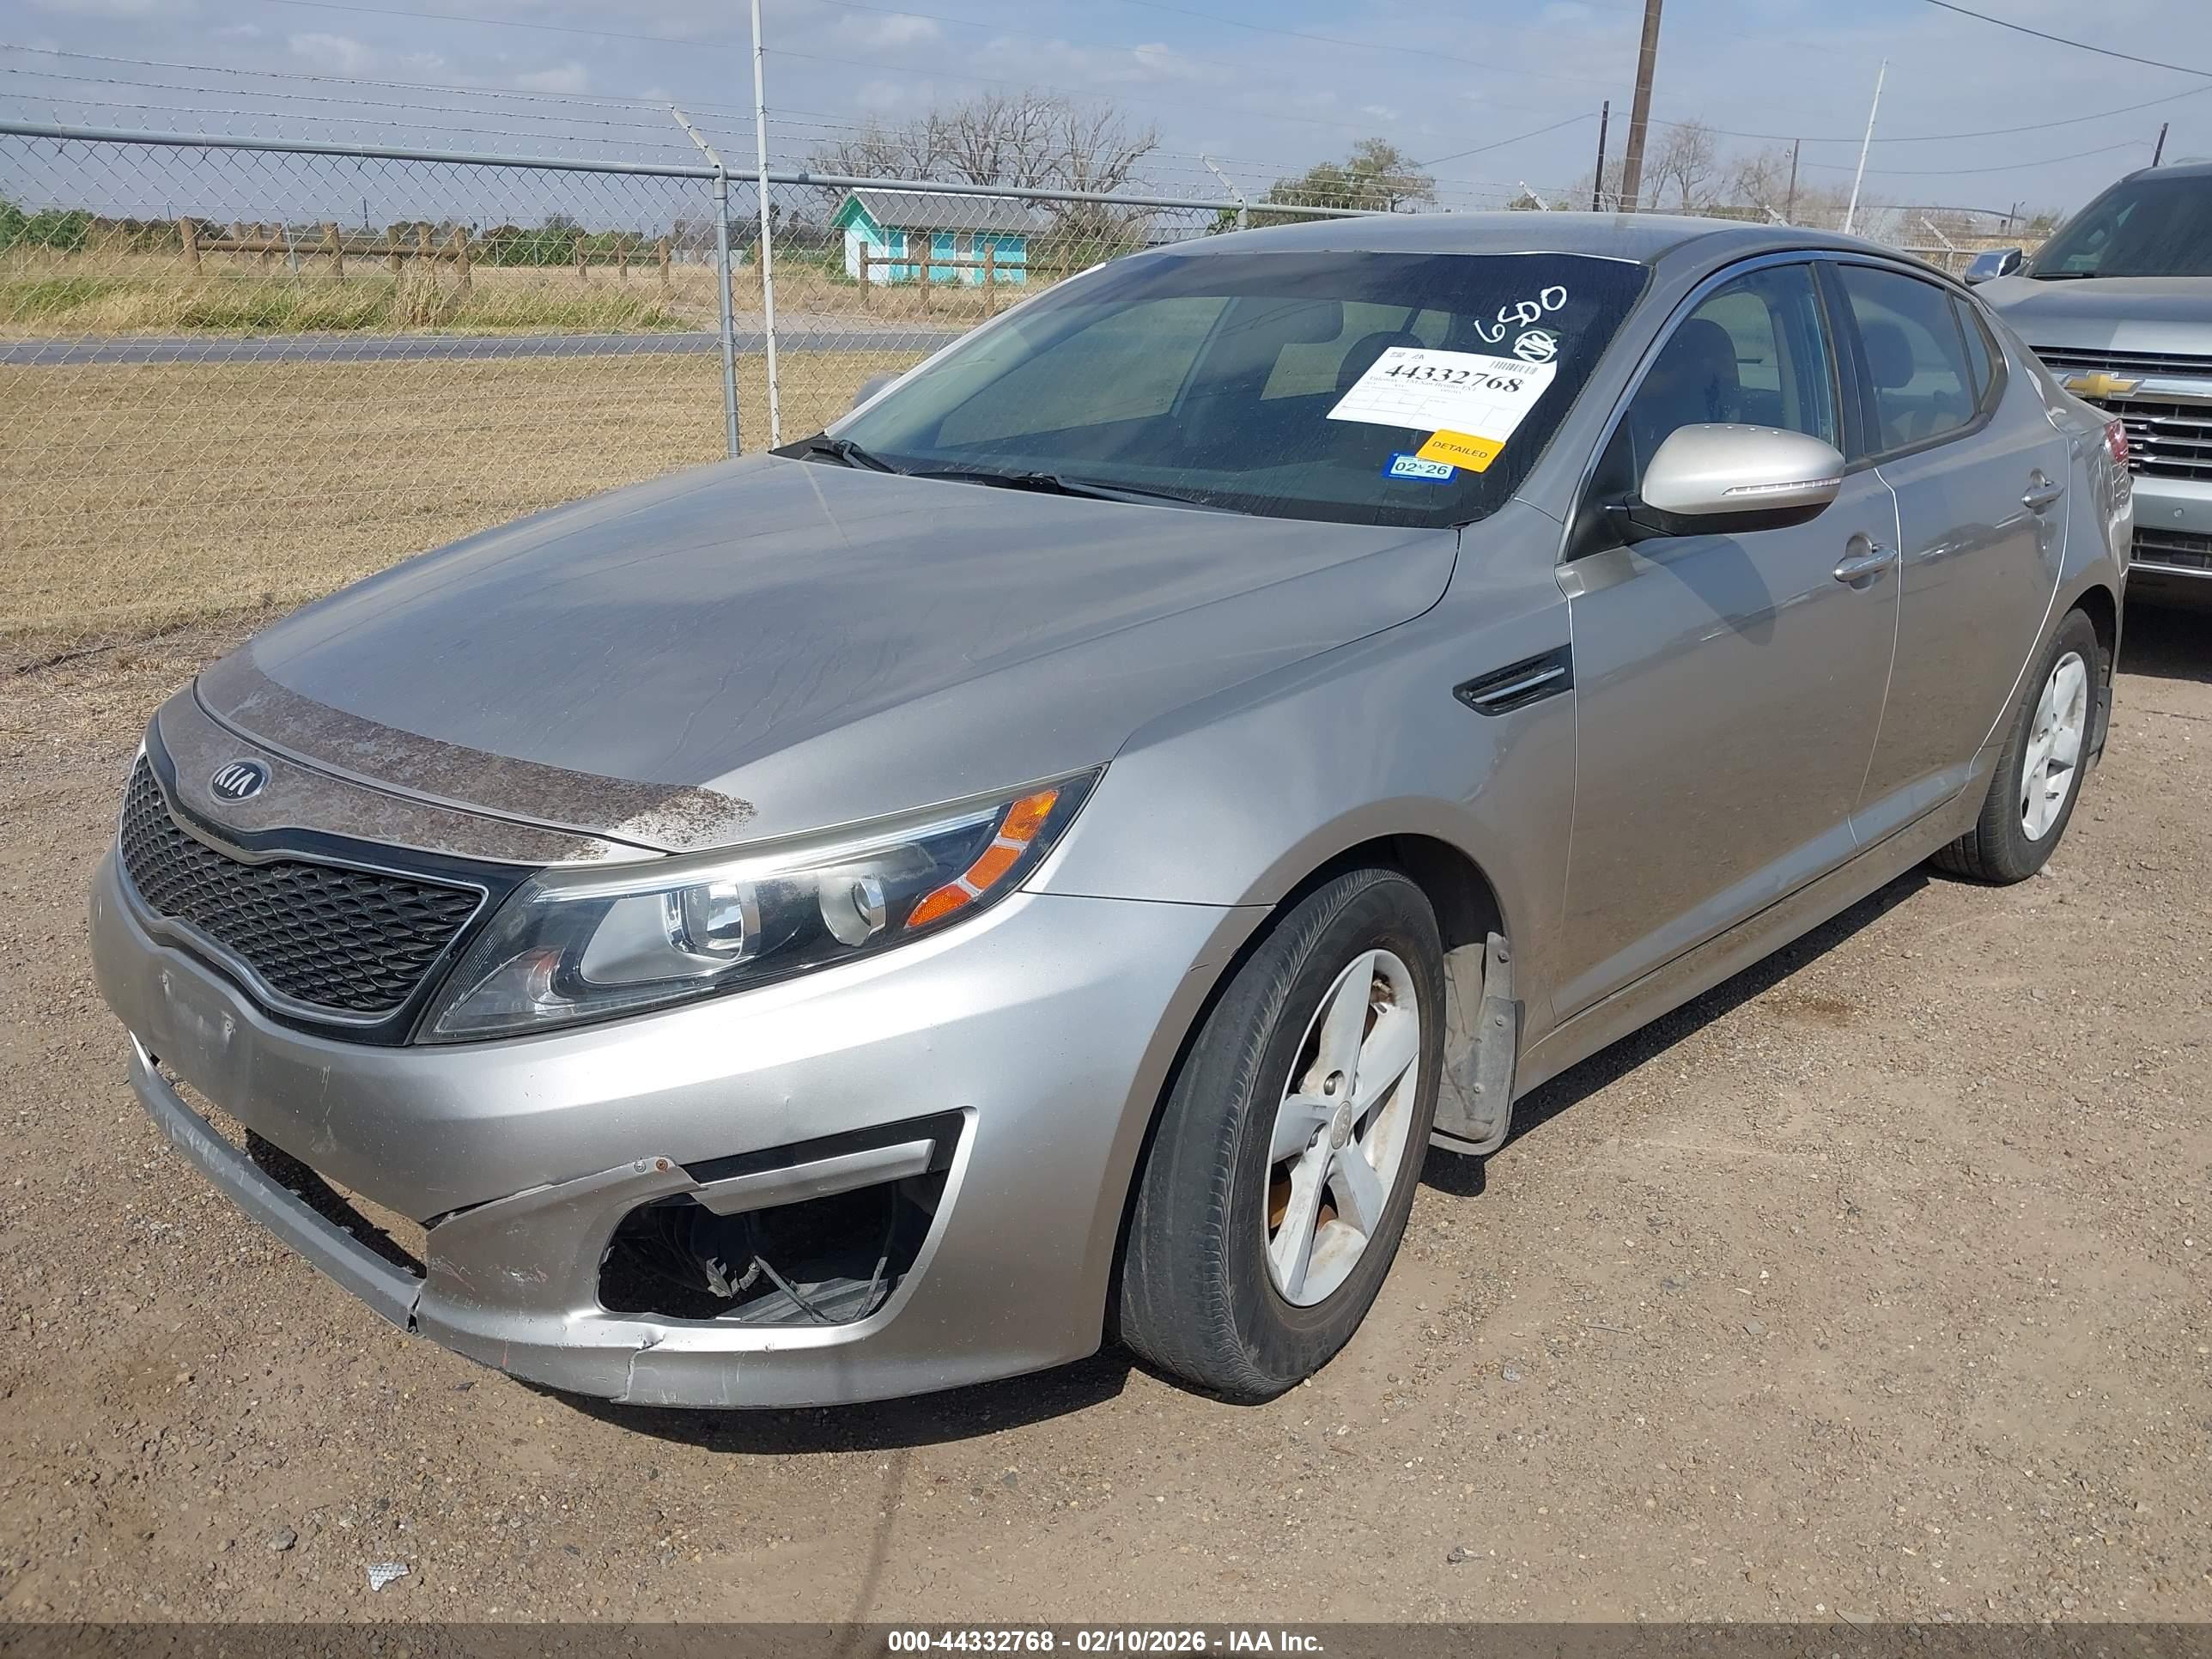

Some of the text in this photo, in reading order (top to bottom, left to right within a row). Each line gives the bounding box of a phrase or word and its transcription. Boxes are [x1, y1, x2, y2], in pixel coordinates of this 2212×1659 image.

[1384, 363, 1523, 393] 44332768
[1431, 441, 1488, 459] DETAILED
[1395, 461, 1449, 475] 02 26
[214, 763, 257, 796] KIA
